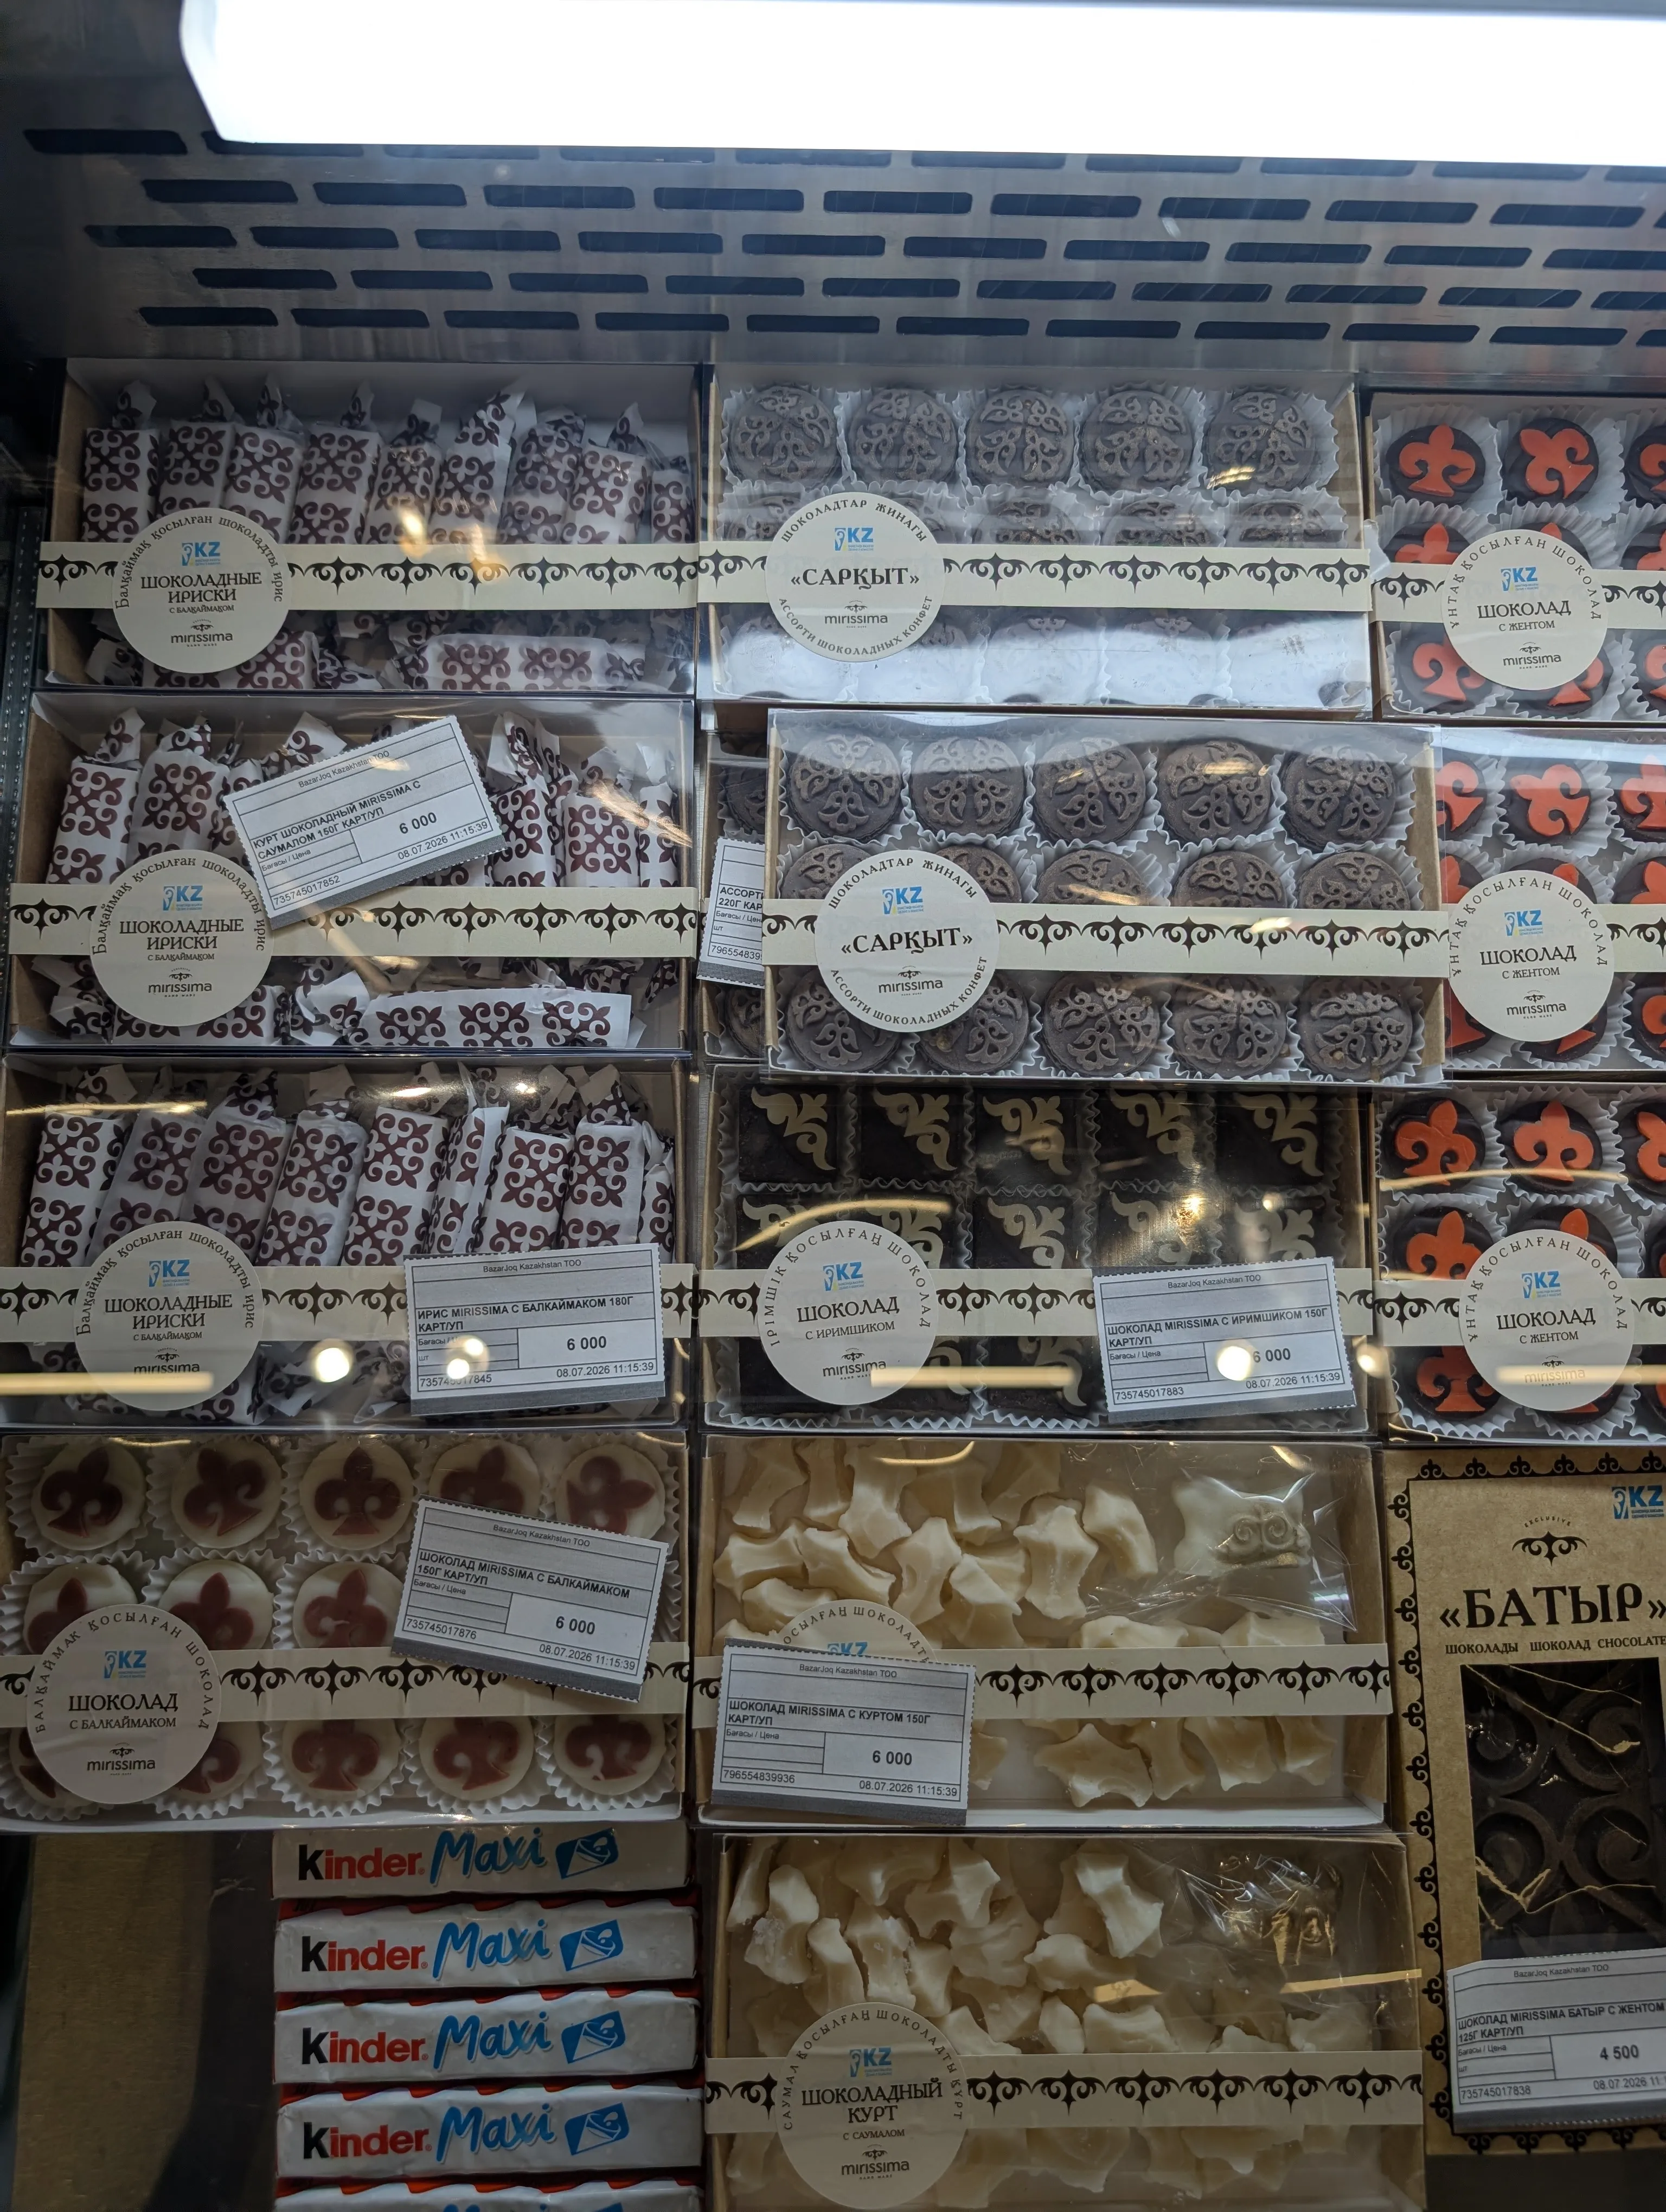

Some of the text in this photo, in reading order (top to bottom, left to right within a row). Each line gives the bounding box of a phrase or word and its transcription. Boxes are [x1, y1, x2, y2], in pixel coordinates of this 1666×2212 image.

[781, 499, 927, 542] ШОКОЛАДТАР ЖИНАГЫ
[151, 516, 212, 540] қосылған
[219, 517, 278, 568] шоколадты
[272, 572, 283, 602] ирис
[141, 573, 261, 589] ШОКОЛАДНЫЕ
[791, 568, 919, 590] «САРҚЫТ»
[1461, 536, 1546, 570] ҚОСЫЛҒАН
[1552, 545, 1601, 619] ШОКОЛАД
[169, 589, 236, 603] ИРИСКИ
[824, 614, 888, 624] mirissima
[1477, 601, 1571, 619] ШОКОЛАД
[779, 596, 932, 655] АССОРТИ ШОКОЛАДНЫХ КОНФЕТ
[1510, 621, 1555, 631] ЖЕНТОМ
[171, 633, 233, 643] mirissima
[1503, 654, 1561, 666] mirissima
[253, 833, 279, 849] КУРТ
[280, 803, 357, 839] ШОКОЛАДНЫЙ
[354, 786, 411, 812] MIRISSIMA
[399, 812, 437, 834] 6 000
[258, 807, 384, 860] САУМАЛОМ 150Г КАРТ/УП
[273, 875, 341, 905] 735745017852
[828, 858, 977, 909] ШОКОЛАДТАР ЖИНАГЫ
[719, 898, 741, 906] 220Г
[896, 886, 922, 904] KZ
[120, 919, 244, 935] ШОКОЛАДНЫЕ
[1463, 877, 1553, 914] ҚОСЫЛҒАН
[1558, 887, 1607, 966] ШОКОЛАД
[147, 936, 217, 949] ИРИСКИ
[841, 928, 972, 954] «САРҚЫТ»
[1480, 946, 1577, 964] ШОКОЛАД
[1513, 967, 1560, 979] ЖЕНТОМ
[149, 983, 212, 993] mirissima
[831, 957, 987, 1025] АССОРТИ ШОКОЛАДНЫХ КОНФЕТ
[879, 980, 943, 993] mirissima
[1507, 1003, 1566, 1015] mirissima
[520, 1261, 562, 1270] Kazakhstan
[887, 1242, 931, 1327] ШОКОЛАД
[105, 1294, 233, 1313] ШОКОЛАДНЫЕ
[418, 1309, 448, 1320] ИРИС
[452, 1306, 509, 1317] MIRISSIMA
[522, 1298, 606, 1313] БАЛКАЙМАКОМ
[610, 1296, 633, 1306] 180Г
[797, 1296, 899, 1322] ШОКОЛАД
[133, 1313, 205, 1329] ИРИСКИ
[419, 1321, 464, 1332] КАРТ/УП
[1107, 1323, 1162, 1335] ШОКОЛАД
[1165, 1318, 1219, 1330] MIRISSIMA
[1232, 1311, 1302, 1324] ИРИМШИКОМ
[1305, 1308, 1328, 1318] 150Г
[1496, 1308, 1595, 1329] ШОКОЛАД
[817, 1321, 894, 1339] ИРИМШИКОМ
[567, 1336, 607, 1350] 6 000
[1109, 1336, 1152, 1347] КАРТ/УП
[1143, 1350, 1161, 1359] Цена
[1253, 1348, 1291, 1362] 6 000
[556, 1362, 653, 1377] 08.07.2026 11:15:39
[823, 1360, 886, 1377] mirissima
[1246, 1373, 1340, 1388] 08.07.2026 11:15:39
[1116, 1387, 1184, 1400] 735745017883
[1629, 1485, 1664, 1507] KZ
[1524, 1516, 1571, 1527] EXCLUSIVE
[417, 1565, 488, 1585] 150Г КАРТ/УП
[419, 1551, 475, 1571] ШОКОЛАД
[478, 1562, 534, 1580] MIRISSIMA
[547, 1575, 630, 1598] БАЛКАЙМАКОМ
[1439, 1583, 1666, 1628] «БАТЫР»
[406, 1618, 477, 1639] 735745017876
[555, 1616, 595, 1634] 6 000
[1445, 1636, 1666, 1654] ШОКОЛАДЫ ШОКОЛАД CHOCOLATE
[88, 1612, 182, 1639] ҚОСЫЛҒАН
[186, 1642, 213, 1729] ШОКОЛАД
[799, 1664, 834, 1674] BazarJoq
[836, 1667, 877, 1677] Kazakhstan
[69, 1693, 178, 1711] ШОКОЛАД
[728, 1715, 773, 1726] КАРТ/УП
[729, 1700, 786, 1714] ШОКОЛАД
[789, 1706, 845, 1718] MIRISSIMA
[858, 1711, 903, 1722] КУРТОМ
[906, 1714, 931, 1724] 150Г
[69, 1716, 176, 1729] С БАЛКАЙМАКОМ
[87, 1759, 155, 1771] mirissima
[872, 1750, 912, 1765] 6 000
[723, 1769, 795, 1783] 796554839936
[859, 1780, 957, 1796] 08.07.2026 11:15:39
[430, 1827, 548, 1886] Maxi
[433, 1919, 550, 1981] Maxi
[1458, 2014, 1508, 2030] ШОКОЛАД
[1511, 2009, 1565, 2022] MIRISSIMA
[1568, 2004, 1605, 2017] БАТЫР
[1618, 2002, 1664, 2014] ЖЕНТОМ
[434, 2011, 552, 2071] Maxi
[1459, 2026, 1523, 2042] 125Г КАРТ/УП
[1600, 2044, 1639, 2060] 4 500
[783, 2065, 798, 2130] САУМАЛ
[876, 2010, 957, 2073] ШОКОЛАДТЫ
[802, 2078, 943, 2106] ШОКОЛАДНЫЙ
[848, 2105, 898, 2123] КУРТ
[437, 2103, 554, 2163] Maxi
[853, 2129, 905, 2139] САУМАЛОМ
[842, 2160, 909, 2175] mirissima
